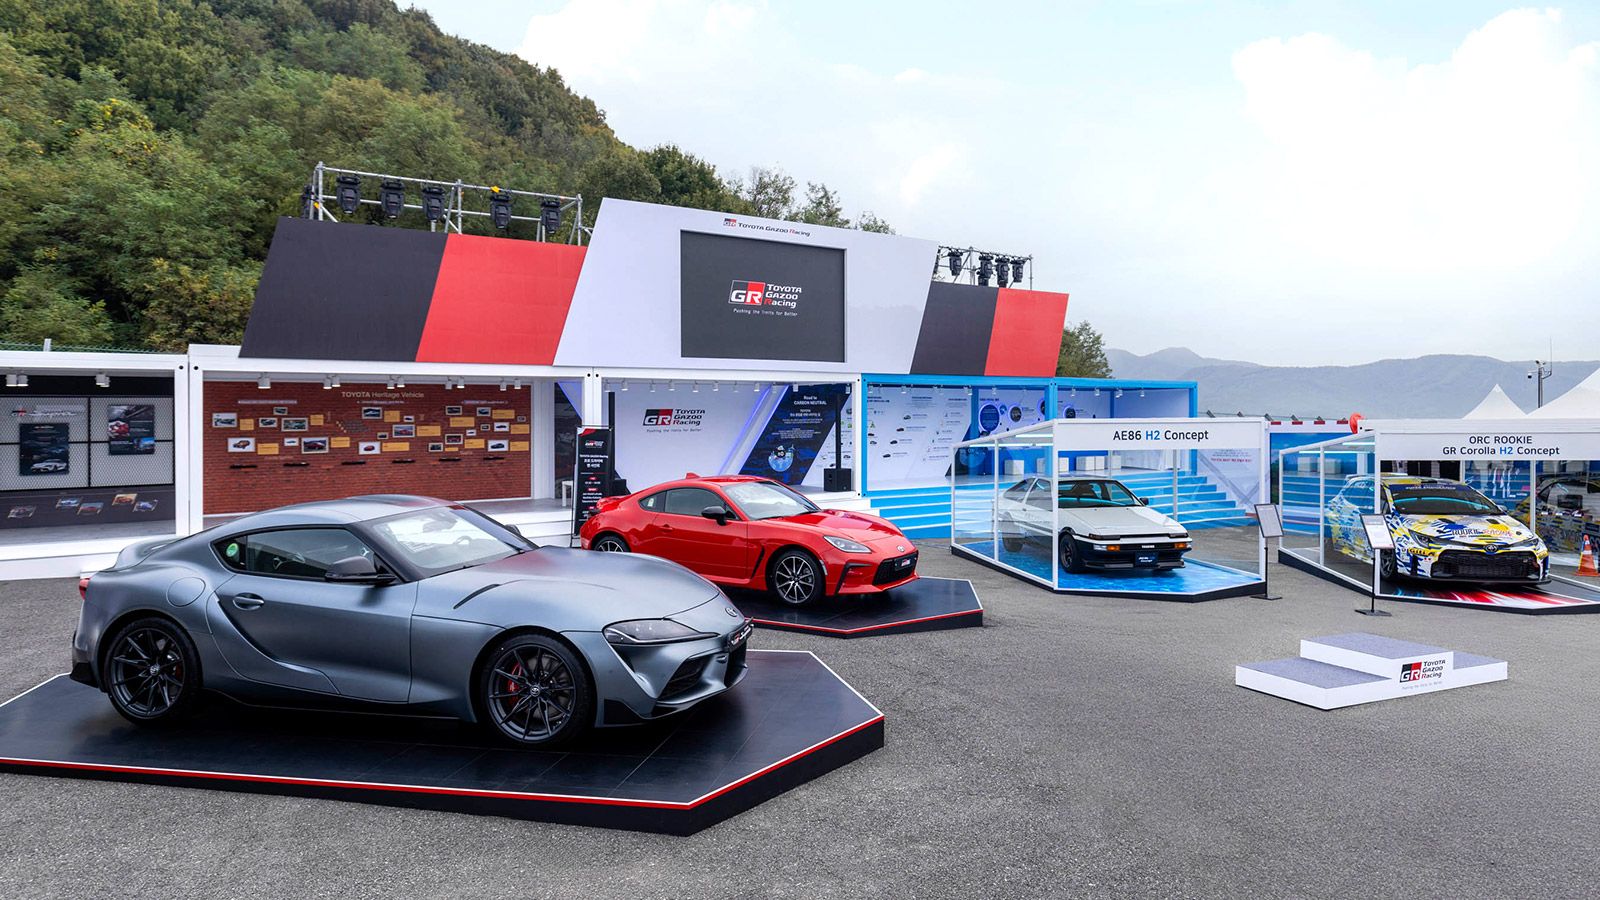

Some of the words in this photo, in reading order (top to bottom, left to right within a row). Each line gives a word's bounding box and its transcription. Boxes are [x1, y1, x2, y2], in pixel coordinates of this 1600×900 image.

[738, 222, 764, 231] TOYOTA
[765, 226, 788, 234] GAZOO
[789, 228, 810, 237] Racing
[766, 283, 802, 293] TOYOTA
[765, 291, 799, 300] GAZOO
[763, 298, 797, 308] Racing
[1113, 430, 1142, 441] AE86
[1145, 430, 1160, 441] H2
[1164, 430, 1209, 442] Concept
[1469, 435, 1490, 444] ORC
[1494, 435, 1533, 444] ROOKIE
[1442, 446, 1457, 455] GR
[1460, 446, 1496, 455] Corolla
[1500, 446, 1513, 455] H2
[1517, 446, 1560, 456] Concept
